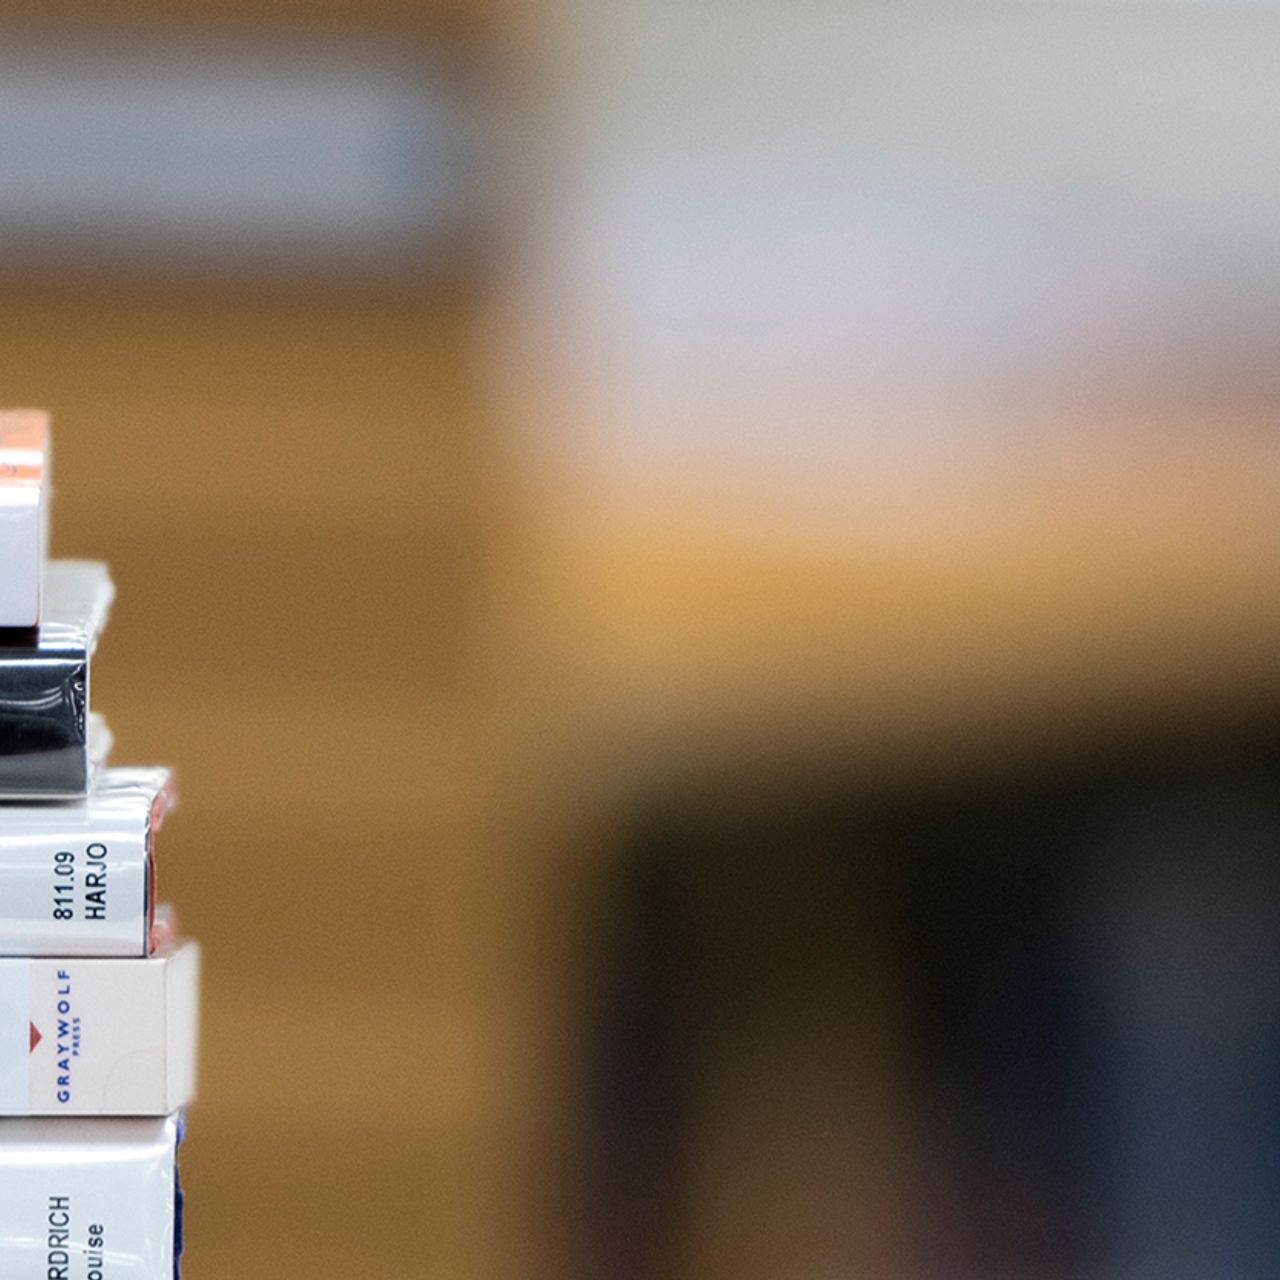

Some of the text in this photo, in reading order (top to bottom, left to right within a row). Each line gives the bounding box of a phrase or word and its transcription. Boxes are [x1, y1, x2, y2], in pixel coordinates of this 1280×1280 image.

[54, 850, 75, 921] 811.09
[86, 843, 107, 921] HARJO
[57, 970, 70, 1103] GRAYWOLF
[72, 1017, 81, 1056] PRESS
